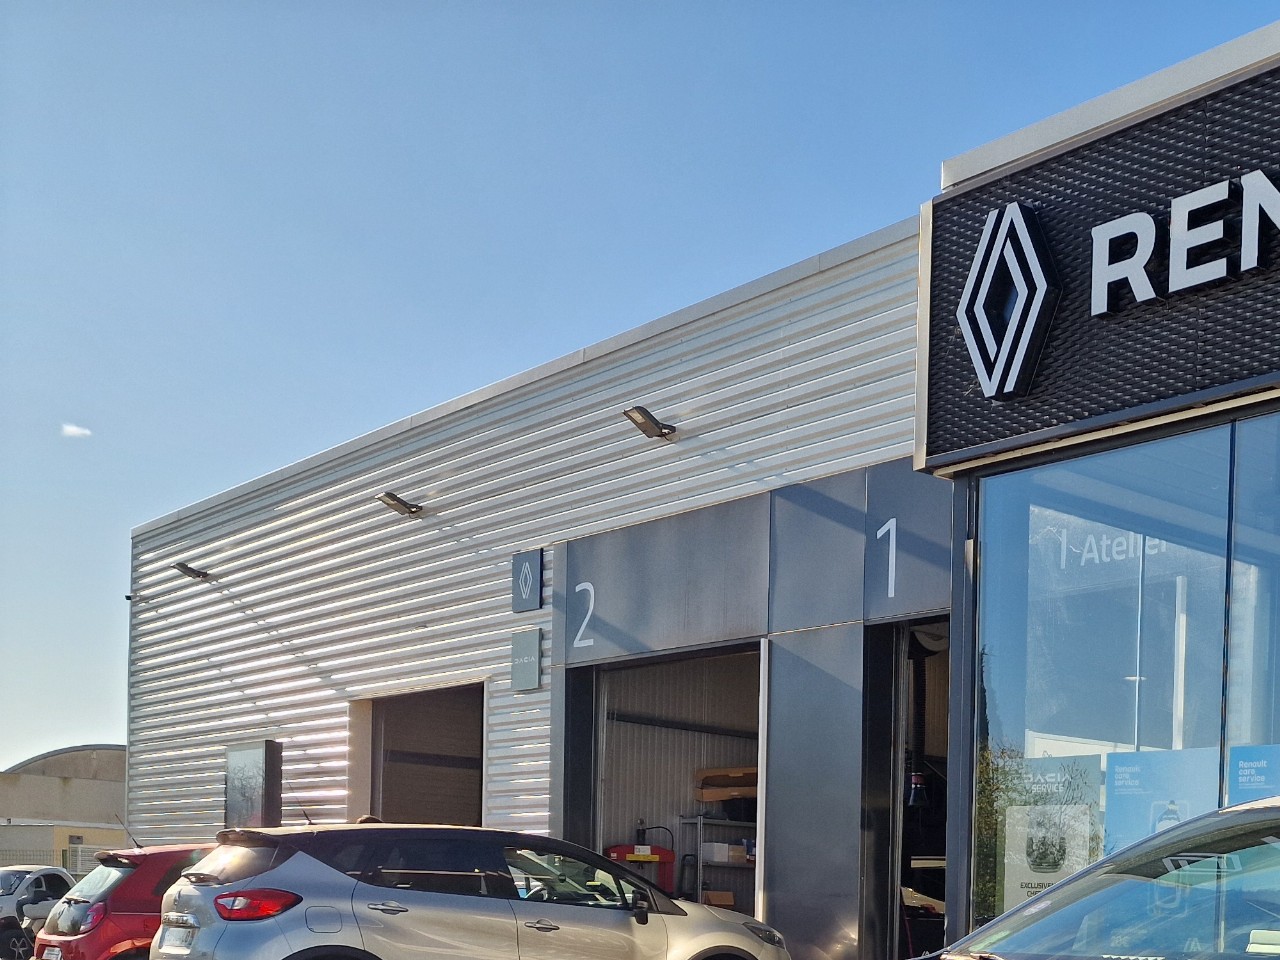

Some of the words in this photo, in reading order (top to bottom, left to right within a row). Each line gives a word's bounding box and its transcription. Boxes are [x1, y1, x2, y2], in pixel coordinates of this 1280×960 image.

[876, 517, 897, 598] 1
[572, 582, 596, 648] 2
[1239, 759, 1267, 768] Renault
[1239, 768, 1256, 776] care
[1238, 775, 1266, 783] service
[1031, 783, 1065, 793] SERVICE
